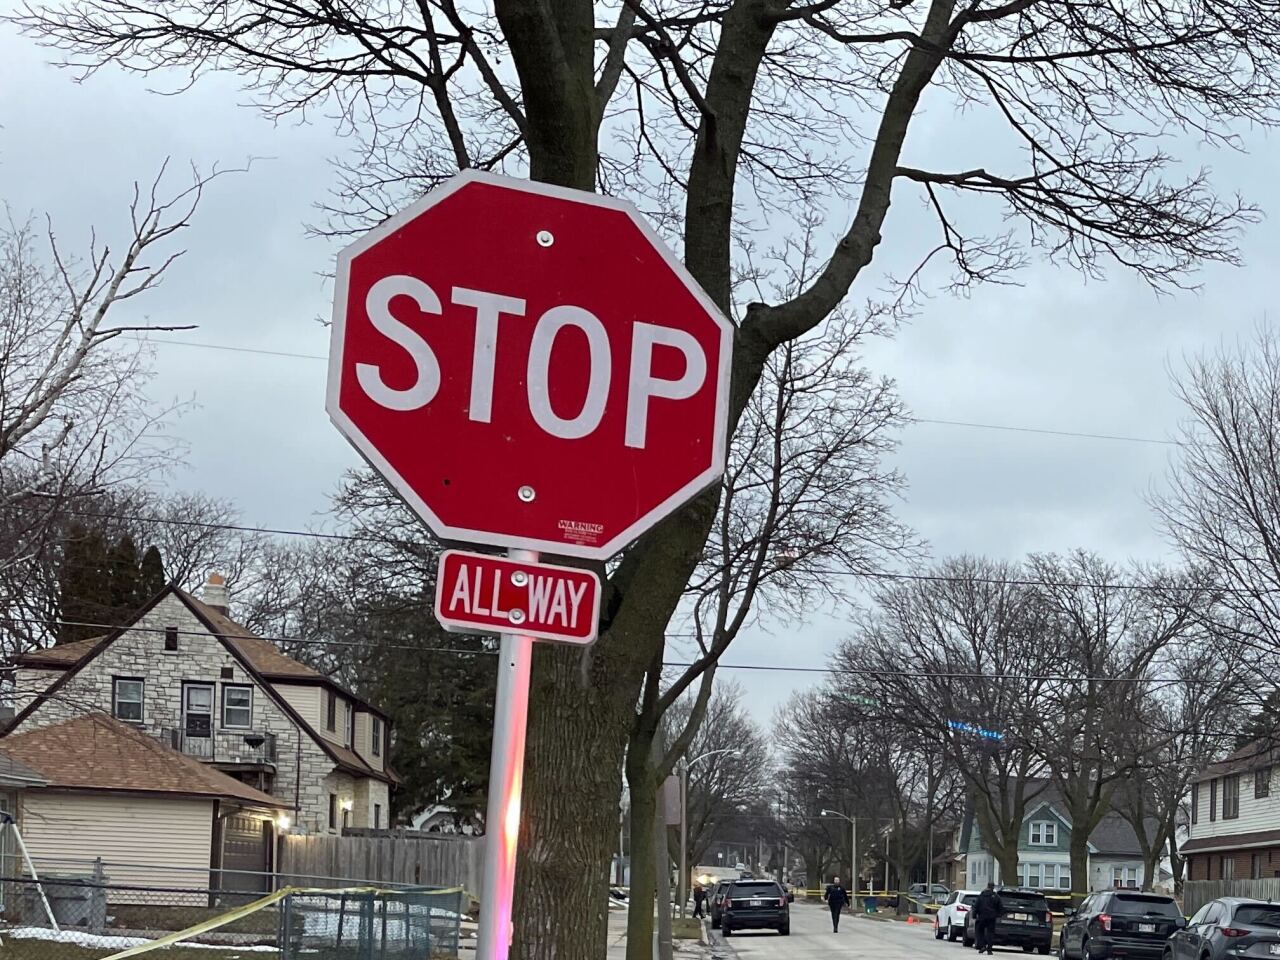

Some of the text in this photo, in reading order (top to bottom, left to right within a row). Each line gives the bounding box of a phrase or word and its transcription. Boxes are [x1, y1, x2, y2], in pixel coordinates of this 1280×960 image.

[355, 273, 708, 450] STOP
[558, 519, 604, 534] WARNING
[449, 563, 588, 629] ALL WAY
